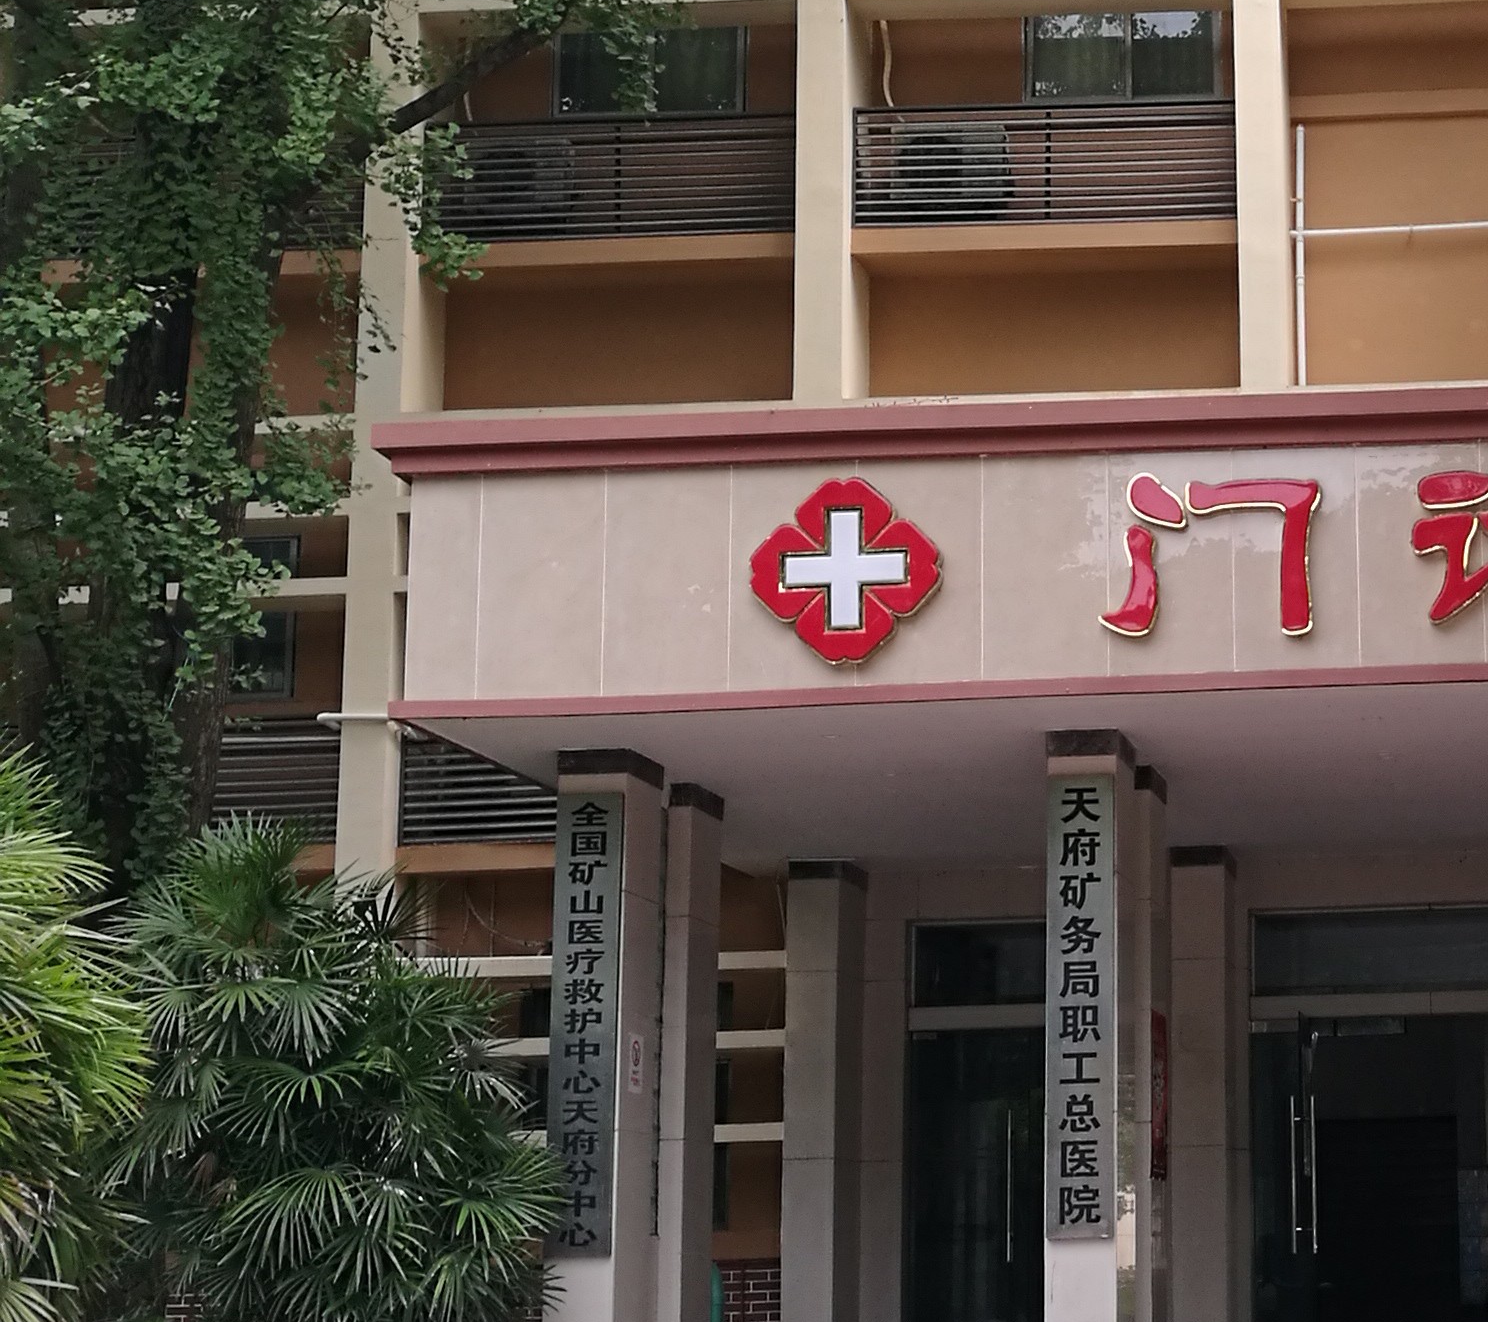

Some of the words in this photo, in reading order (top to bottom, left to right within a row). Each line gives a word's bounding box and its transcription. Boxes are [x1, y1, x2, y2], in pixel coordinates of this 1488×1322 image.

[557, 801, 609, 1249] 全国矿山医疗救护中心天府分中心
[1058, 786, 1102, 1225] 天府矿务局职工总医院
